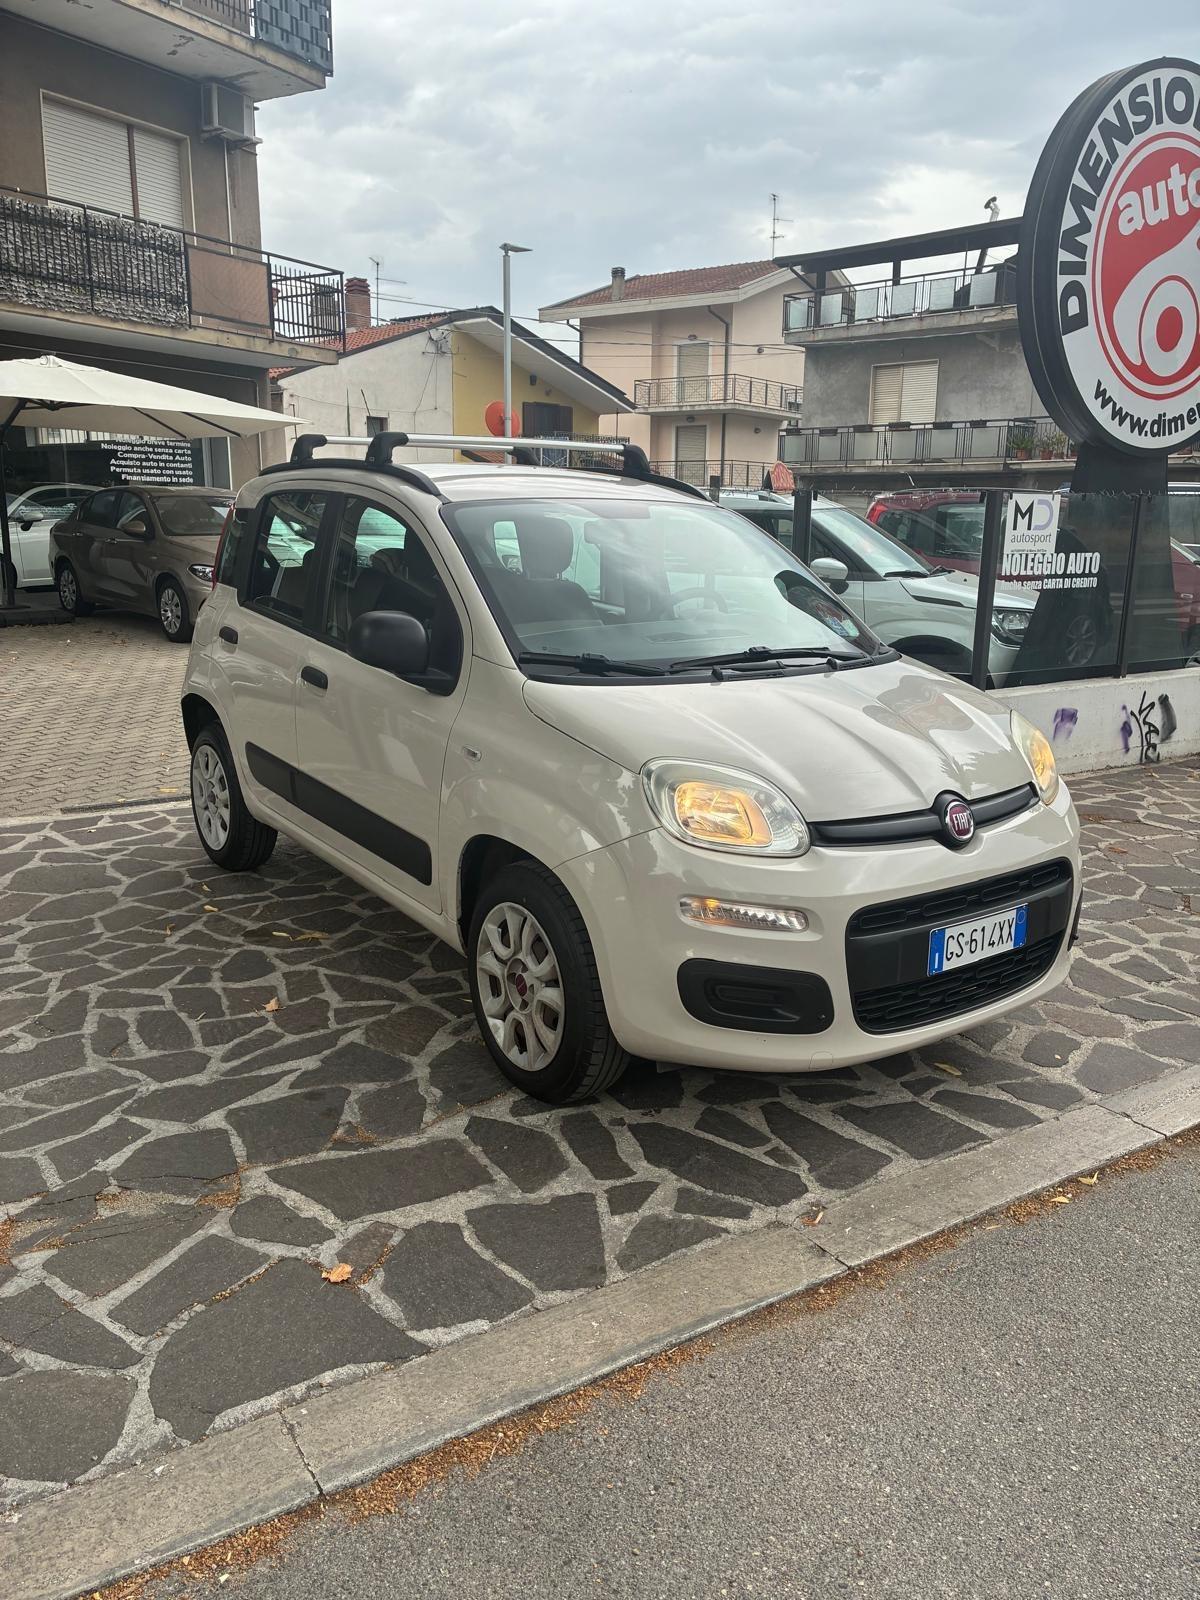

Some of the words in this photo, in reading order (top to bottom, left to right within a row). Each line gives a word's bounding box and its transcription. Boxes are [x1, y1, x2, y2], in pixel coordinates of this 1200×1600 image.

[1059, 76, 1200, 336] DIMENSIO
[101, 443, 131, 451] Noleggio
[117, 452, 173, 460] Compra-Vendita
[110, 459, 140, 467] Acquisto
[1013, 499, 1053, 531] MD
[1010, 533, 1051, 546] autosport
[1002, 553, 1065, 576] NOLEGGIO
[1067, 552, 1100, 574] AUTO
[1043, 578, 1063, 589] CARTA
[1064, 578, 1071, 588] DI
[1072, 577, 1097, 587] CREDITO
[952, 811, 971, 831] FIAT
